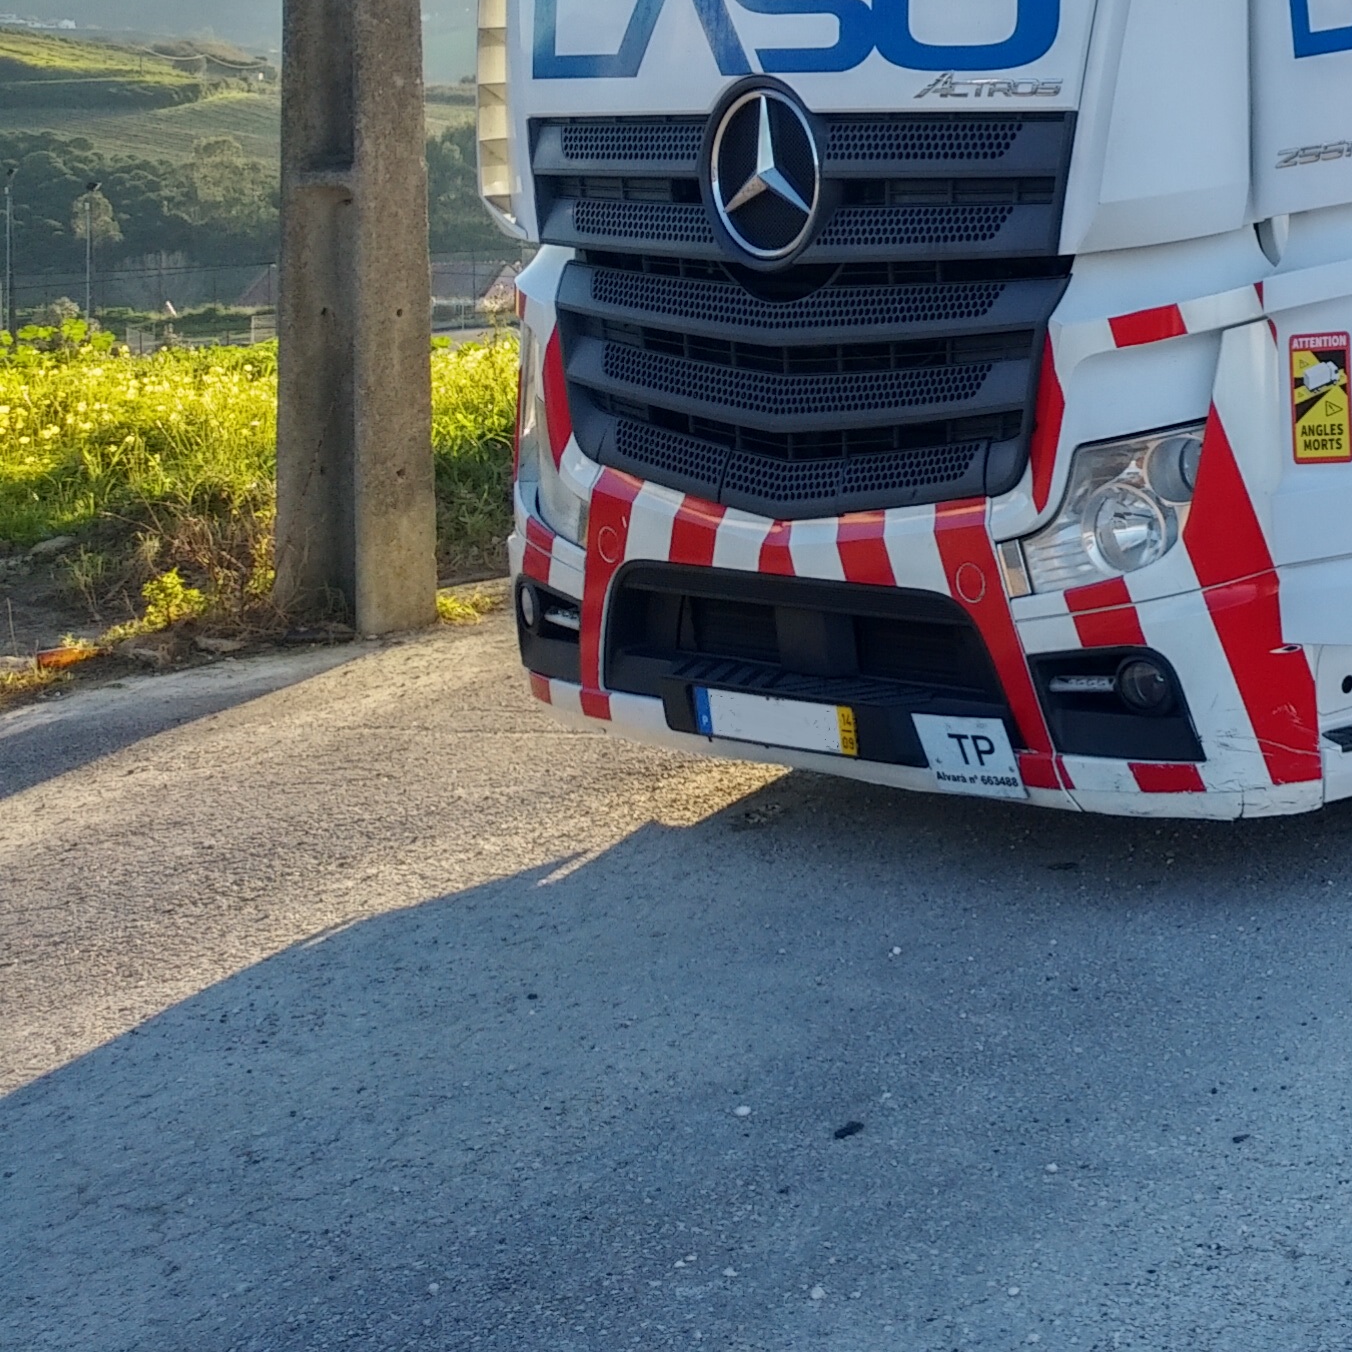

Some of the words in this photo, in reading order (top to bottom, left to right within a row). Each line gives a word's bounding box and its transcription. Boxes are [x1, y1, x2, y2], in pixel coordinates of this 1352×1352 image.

[1292, 335, 1347, 349] ATTENTION
[1301, 424, 1344, 437] ANGLES
[1304, 438, 1343, 452] MORTS
[947, 733, 995, 767] TP
